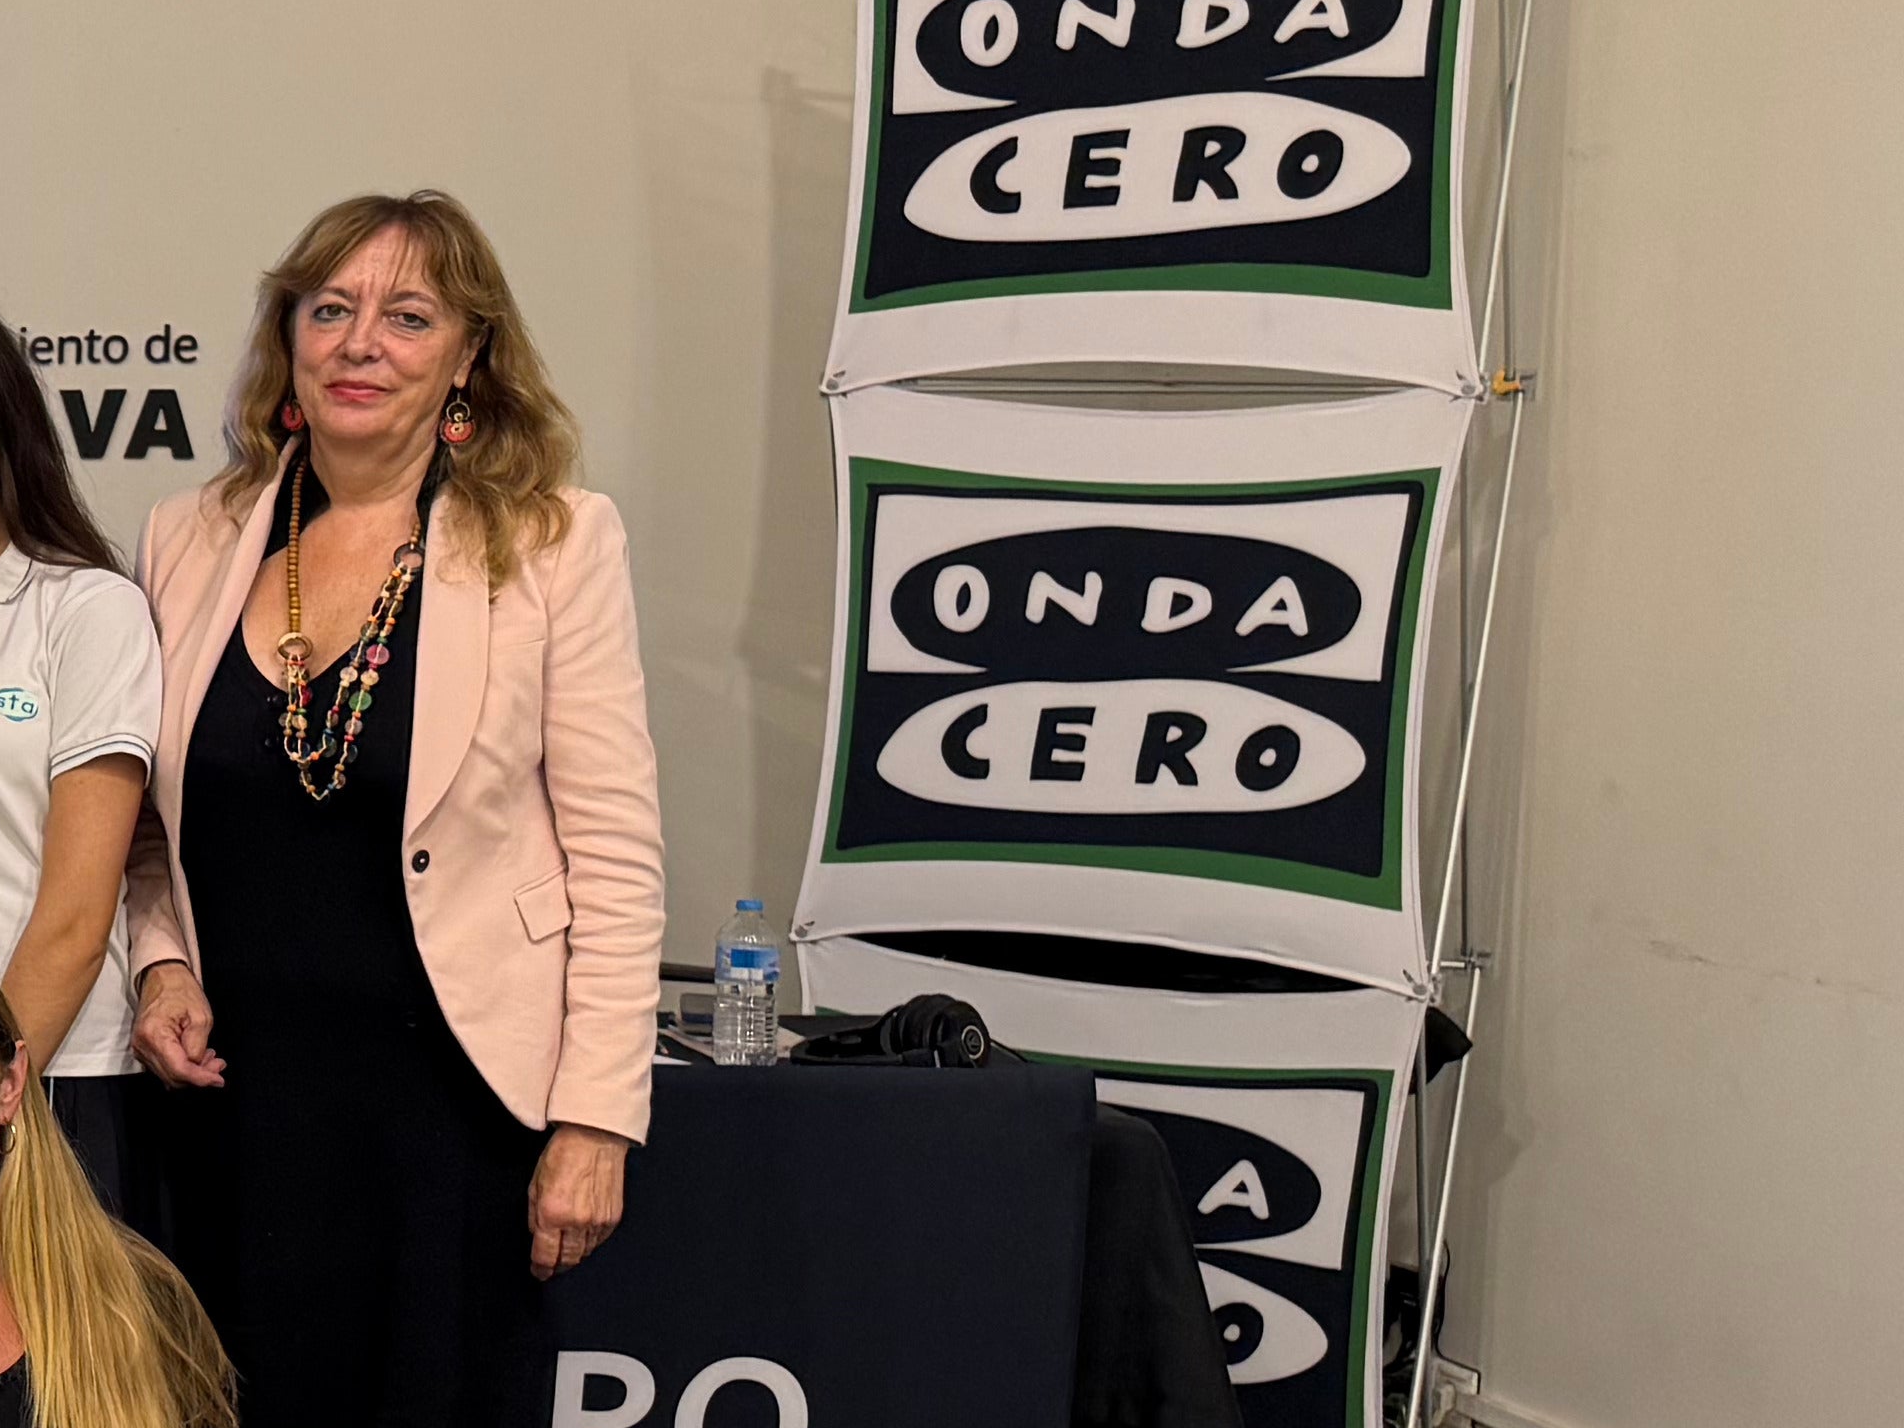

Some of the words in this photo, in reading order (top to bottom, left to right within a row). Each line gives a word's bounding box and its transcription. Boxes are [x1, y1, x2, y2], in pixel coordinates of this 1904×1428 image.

[970, 128, 1344, 214] CERO
[144, 324, 199, 365] de
[933, 564, 1308, 637] ONDA
[940, 703, 1301, 792] CERO
